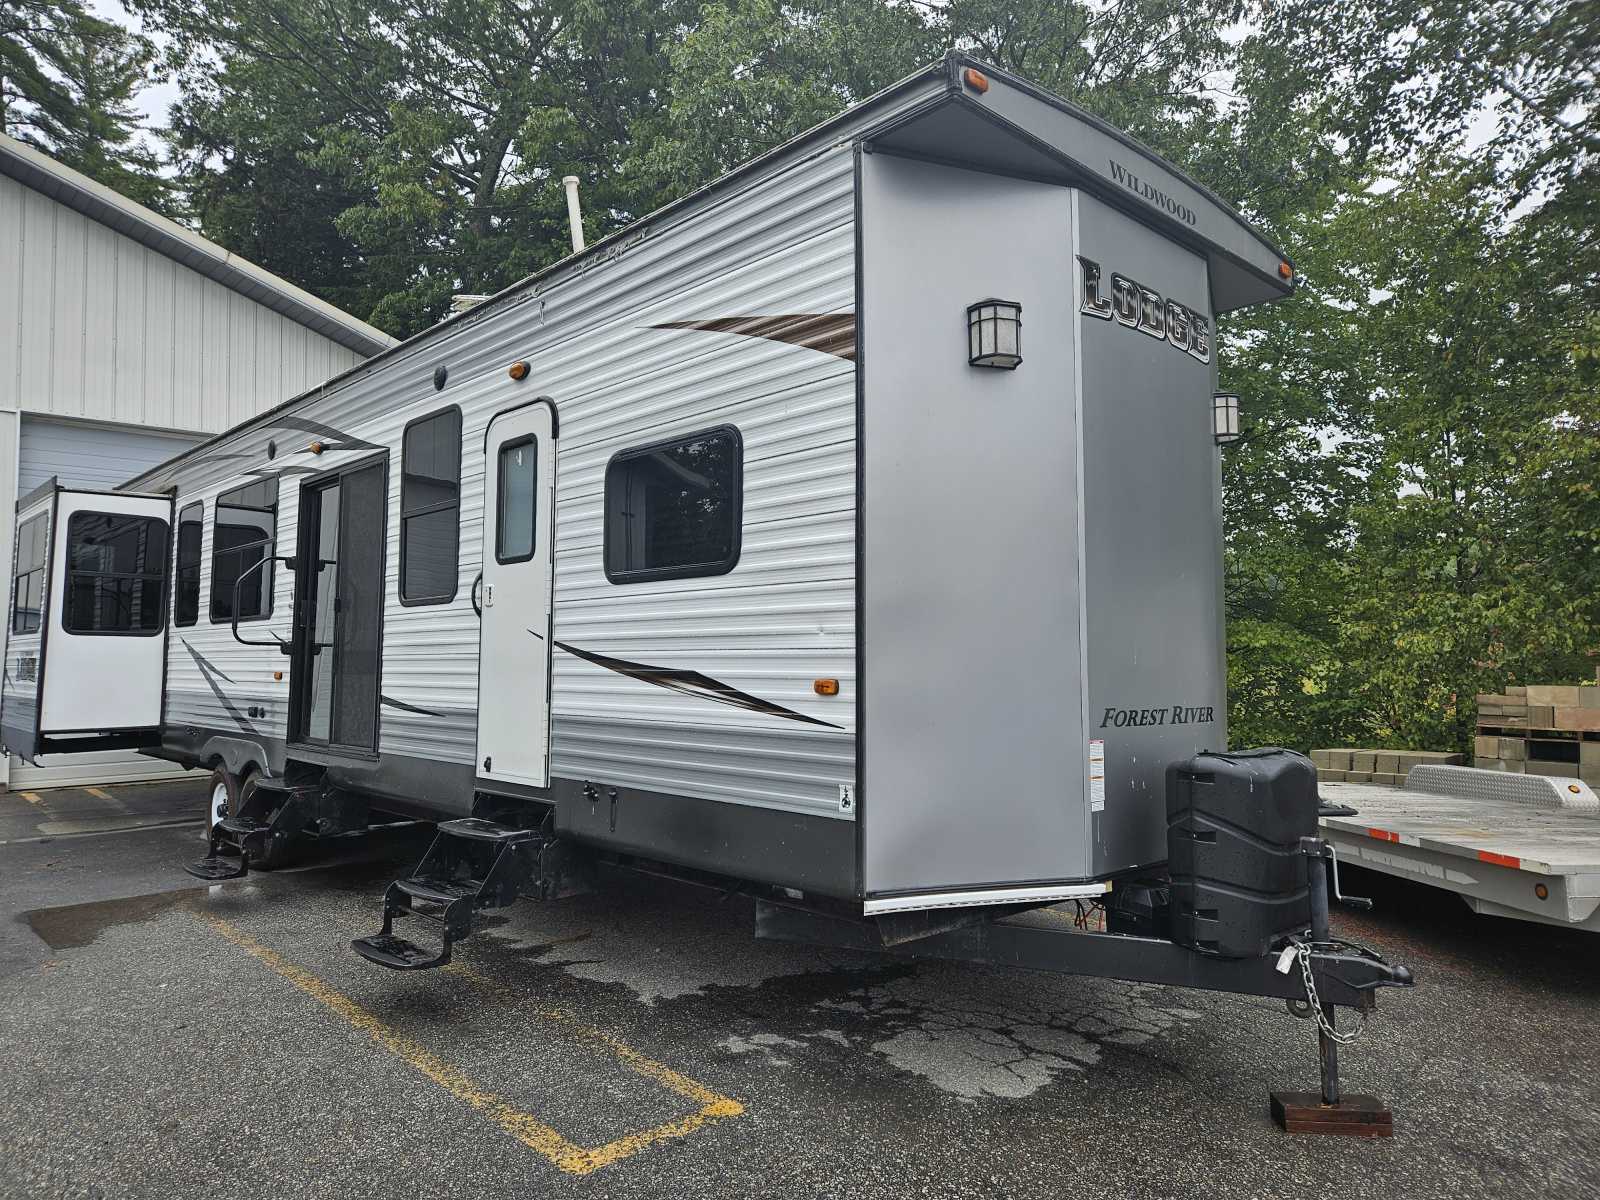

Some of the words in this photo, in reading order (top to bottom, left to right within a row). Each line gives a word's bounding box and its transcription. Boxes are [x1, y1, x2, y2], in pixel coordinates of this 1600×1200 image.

[1109, 160, 1196, 226] WILDWOOD
[1075, 254, 1210, 364] LODGE
[1100, 707, 1168, 728] FOREST
[1171, 705, 1214, 724] RIVER
